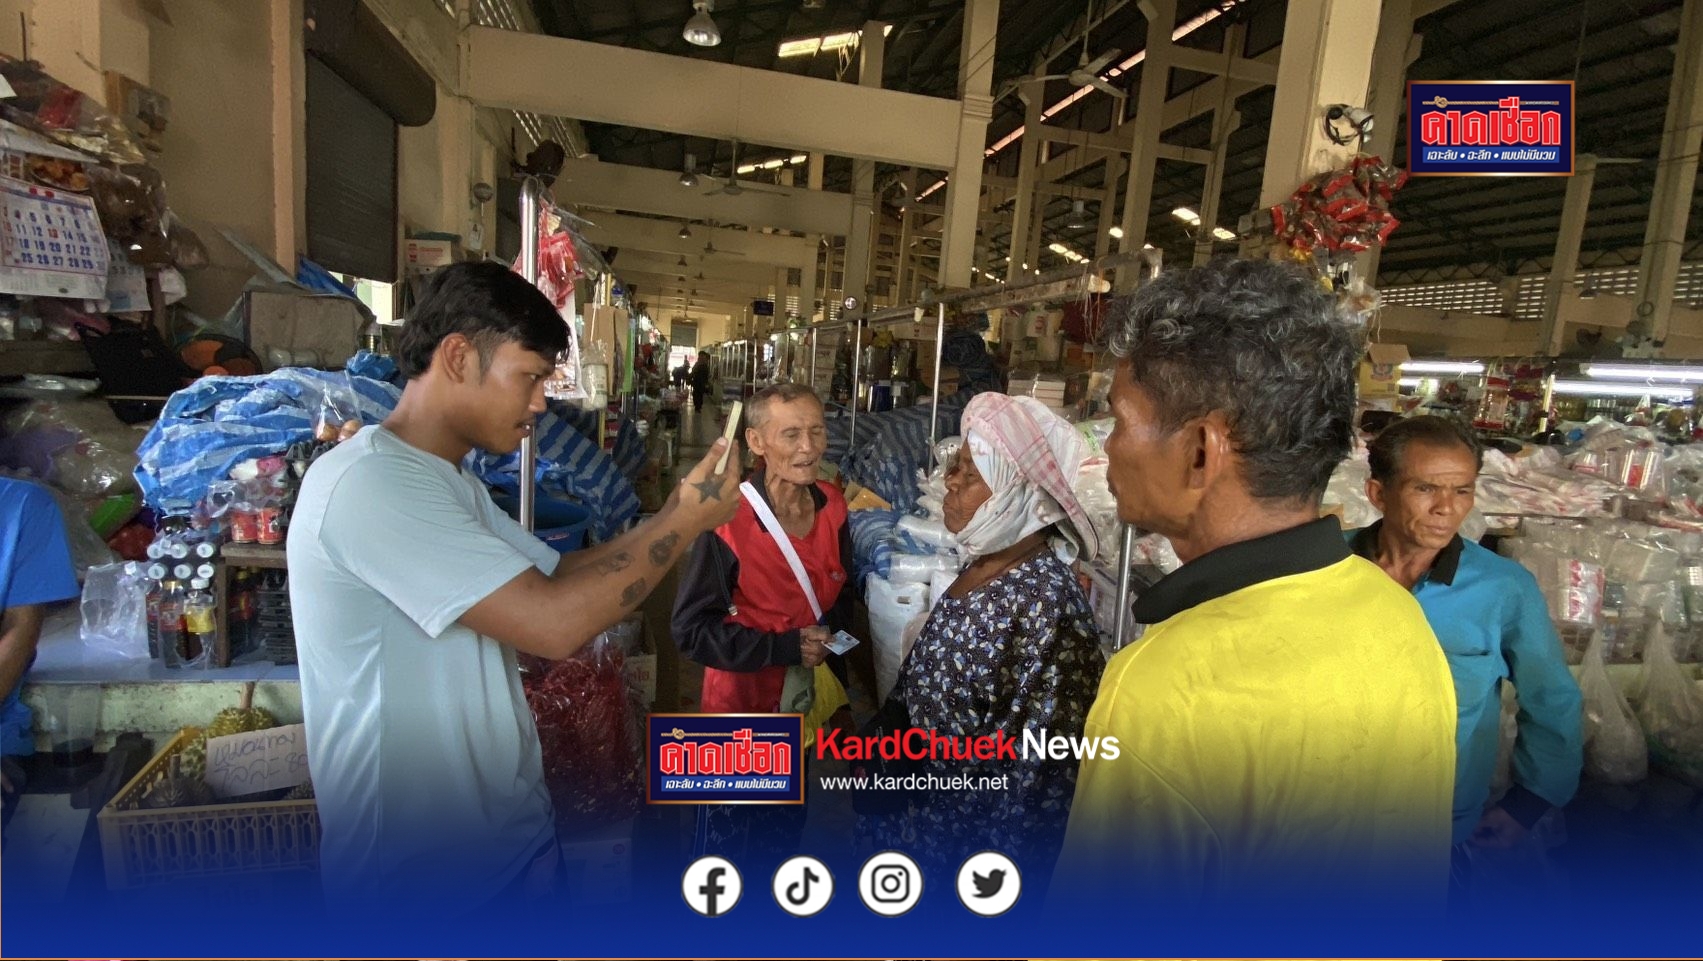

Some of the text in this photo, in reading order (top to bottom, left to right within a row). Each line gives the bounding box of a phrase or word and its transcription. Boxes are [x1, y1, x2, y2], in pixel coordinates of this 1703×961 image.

[32, 226, 43, 237] 12
[62, 230, 74, 241] 14
[48, 241, 61, 253] 20
[65, 243, 76, 254] 21
[80, 245, 91, 256] 22
[21, 252, 34, 264] 25
[52, 256, 64, 266] 27
